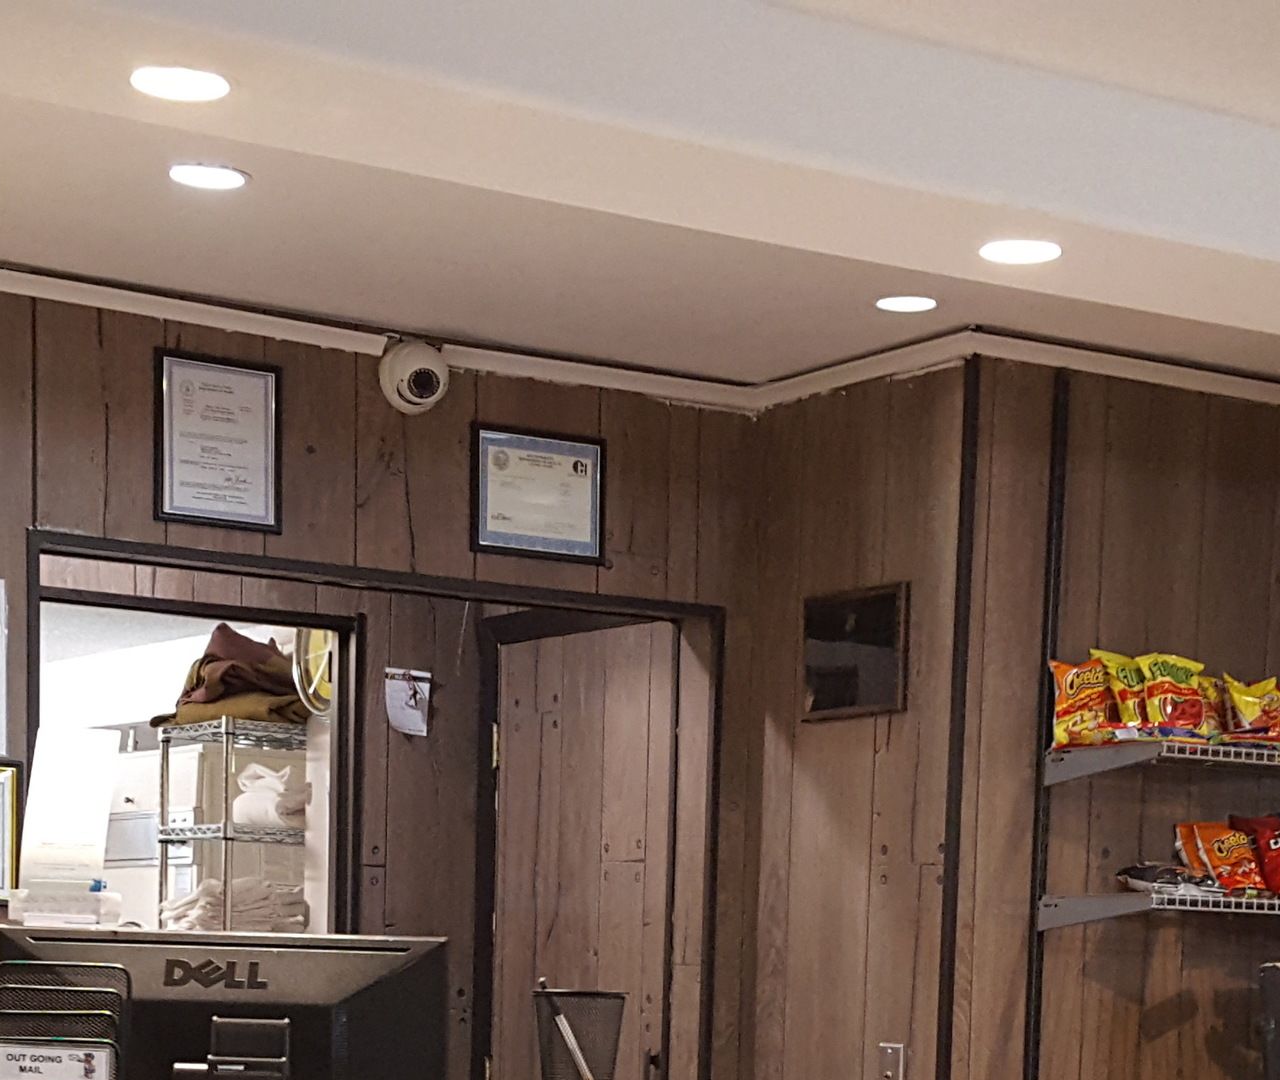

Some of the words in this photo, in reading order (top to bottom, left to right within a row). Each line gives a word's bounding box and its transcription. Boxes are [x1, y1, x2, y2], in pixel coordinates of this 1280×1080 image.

[163, 958, 268, 989] DELL
[6, 1053, 26, 1062] OUT
[30, 1054, 62, 1063] GOING
[19, 1065, 43, 1074] MAIL
